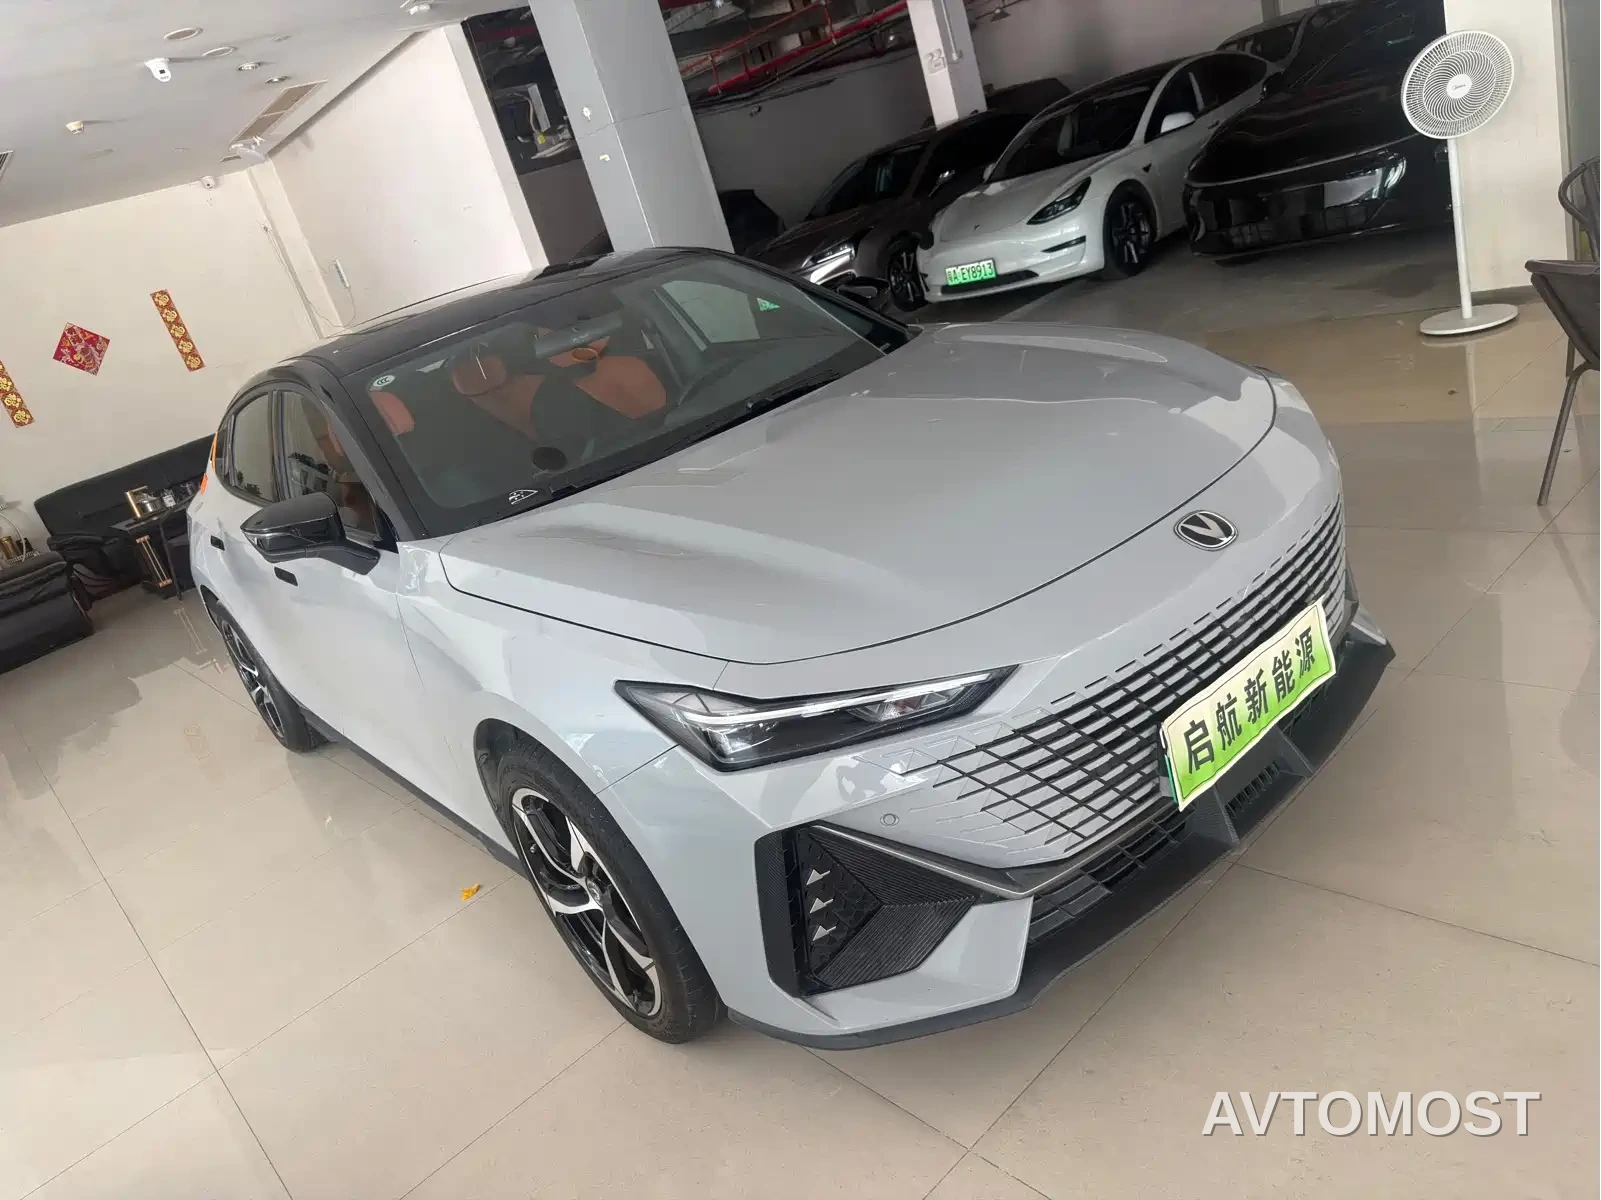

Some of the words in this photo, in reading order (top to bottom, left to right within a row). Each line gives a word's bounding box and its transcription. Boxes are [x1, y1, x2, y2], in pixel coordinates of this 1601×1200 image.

[1183, 626, 1316, 775] 启航新能源
